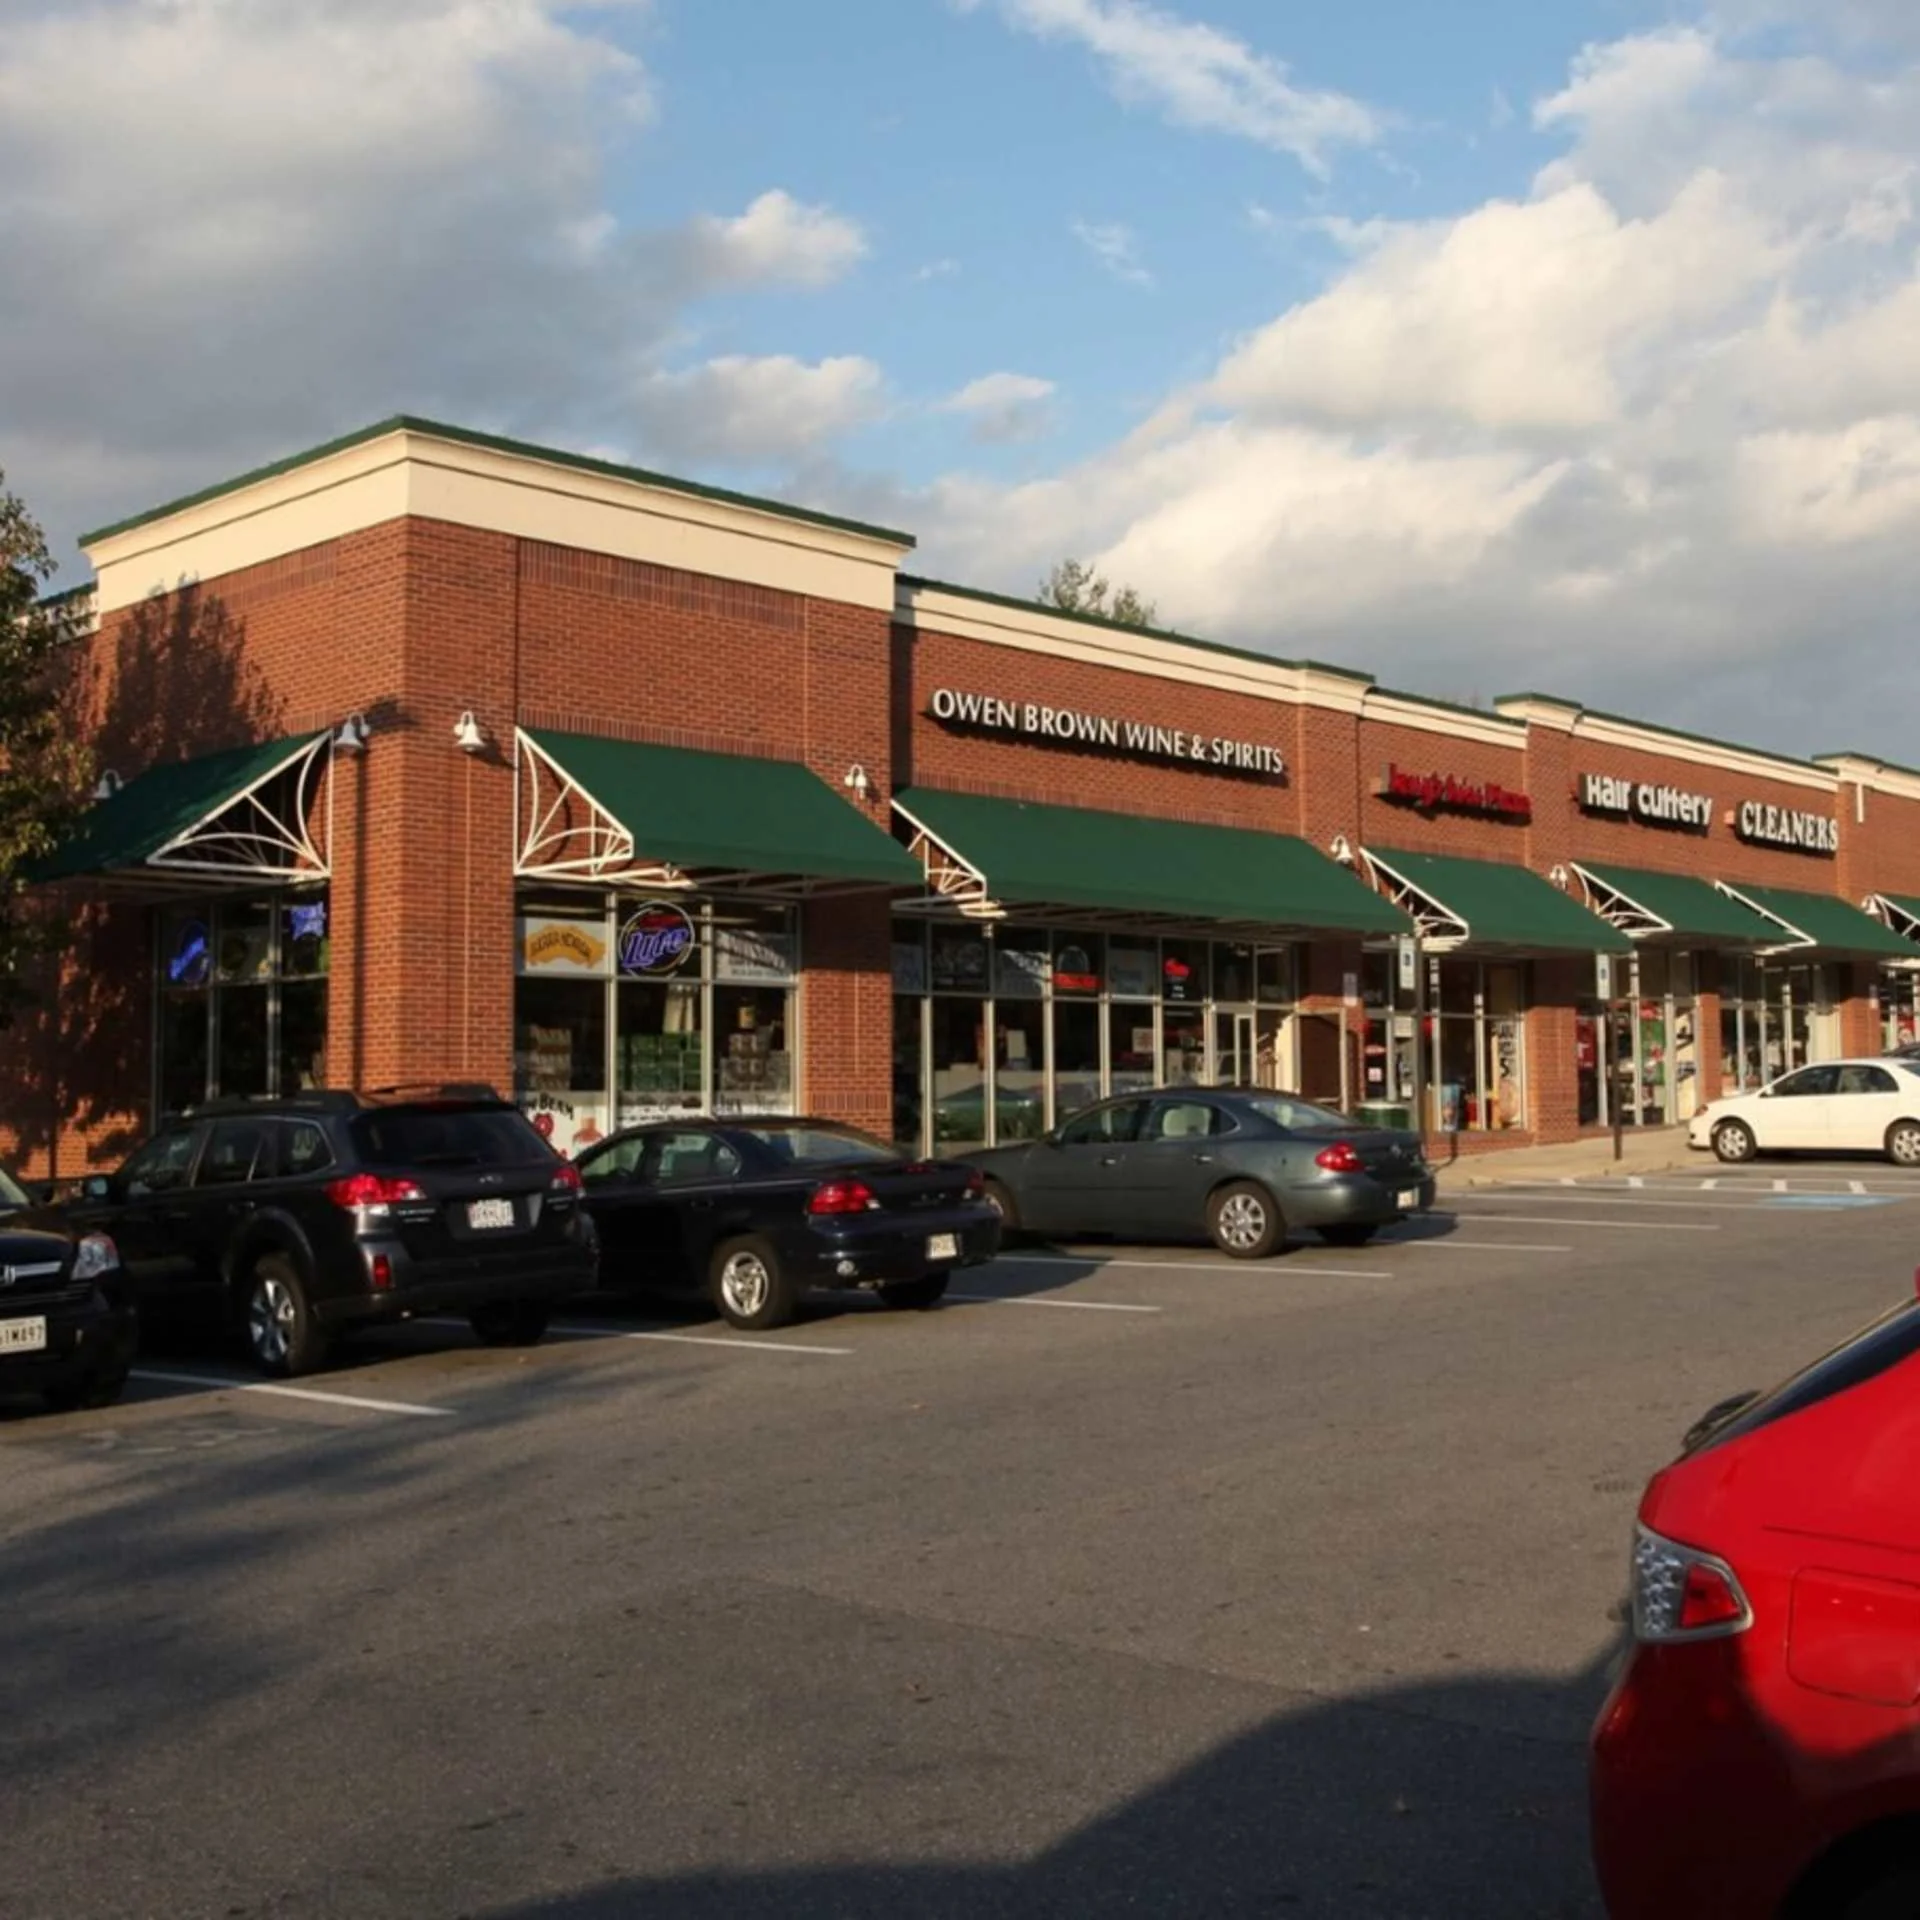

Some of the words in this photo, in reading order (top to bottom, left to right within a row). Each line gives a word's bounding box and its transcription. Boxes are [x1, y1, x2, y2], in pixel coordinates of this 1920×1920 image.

[932, 688, 1017, 730] OWEN
[1023, 704, 1119, 747] BROWN
[1124, 721, 1186, 759] WINE
[1190, 735, 1206, 761] &
[1210, 737, 1284, 774] SPIRITS
[1585, 774, 1632, 811] Hair
[1740, 800, 1839, 850] CLEANERS
